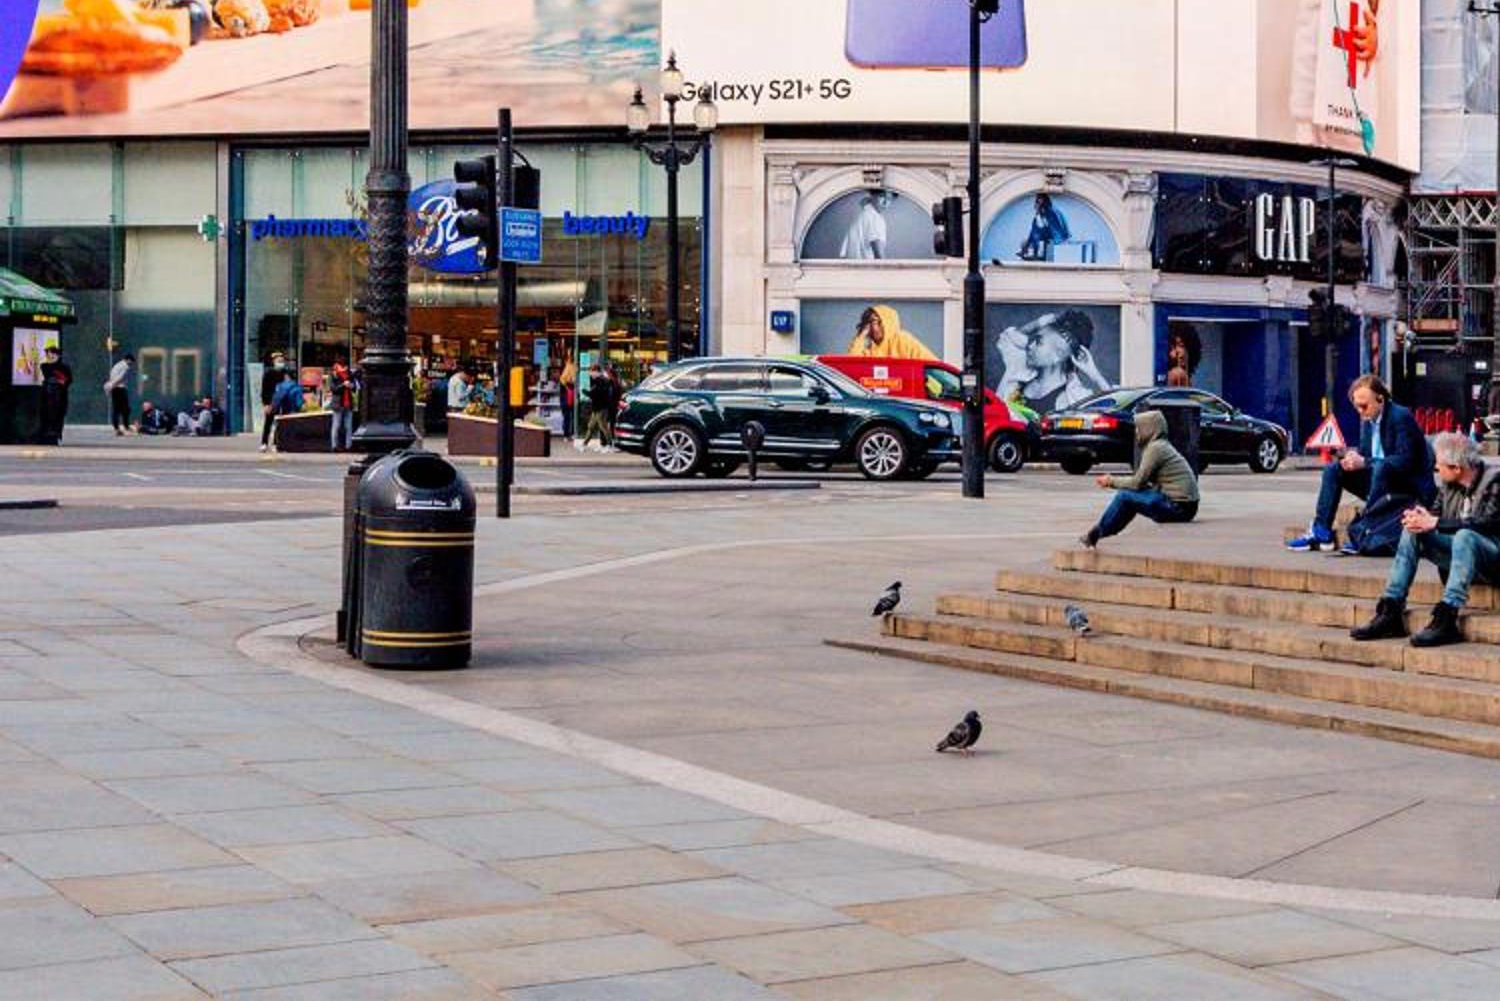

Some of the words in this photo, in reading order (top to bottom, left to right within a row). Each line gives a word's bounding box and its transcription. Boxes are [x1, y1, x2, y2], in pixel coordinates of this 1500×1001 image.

[769, 79, 814, 101] S21+
[819, 78, 852, 99] 5G
[563, 210, 650, 241] beauty
[1255, 192, 1316, 263] GAP
